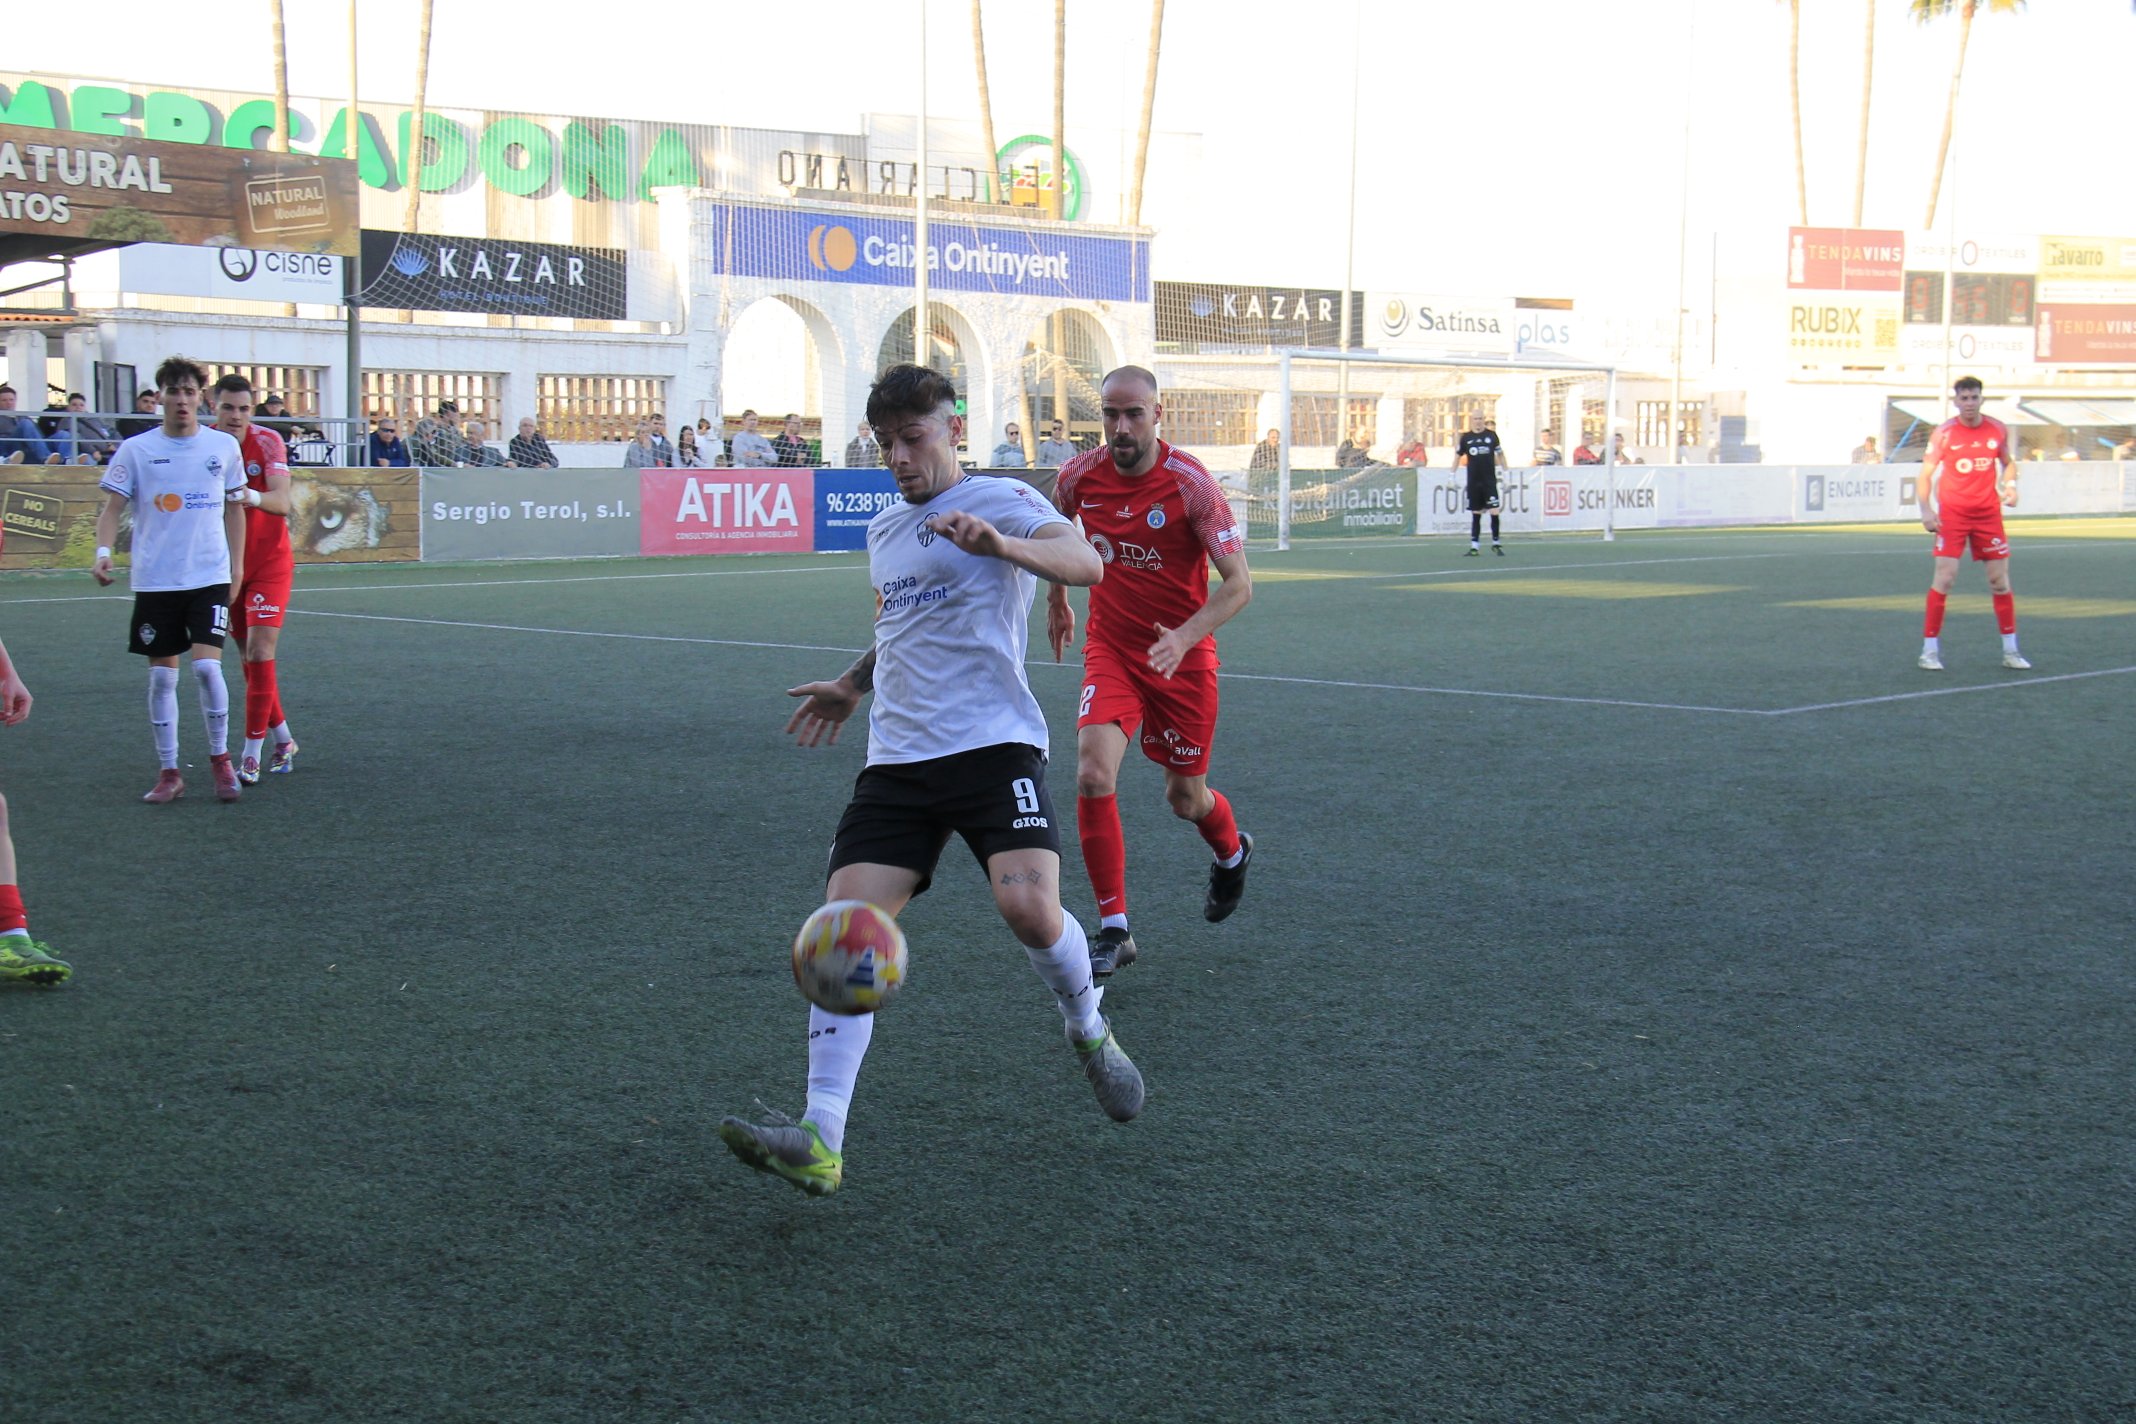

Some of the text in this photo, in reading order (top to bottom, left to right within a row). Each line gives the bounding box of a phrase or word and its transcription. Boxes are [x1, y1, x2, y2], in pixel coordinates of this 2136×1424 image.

[0, 141, 172, 193] ATURAL
[251, 186, 323, 206] NATURAL
[265, 252, 332, 276] cisne
[439, 247, 585, 286] KAZAR
[945, 241, 1069, 284] Ontinyent
[1223, 293, 1332, 322] KAZAR
[1791, 306, 1862, 334] RUBIX
[1418, 307, 1501, 334] Satinsa
[1547, 486, 1655, 510] DB SCHNKER
[1828, 480, 1885, 498] ENCARTE
[23, 499, 45, 512] NO
[432, 500, 632, 525] Sergio Terol, s.l.
[676, 477, 799, 528] ATIKA
[5, 512, 57, 532] CEREALS
[1118, 541, 1163, 563] IDA
[883, 576, 917, 596] Caixa
[883, 586, 948, 612] Ontinyent
[211, 604, 229, 629] 19
[1012, 777, 1040, 814] 9
[1012, 816, 1048, 829] GIOS
